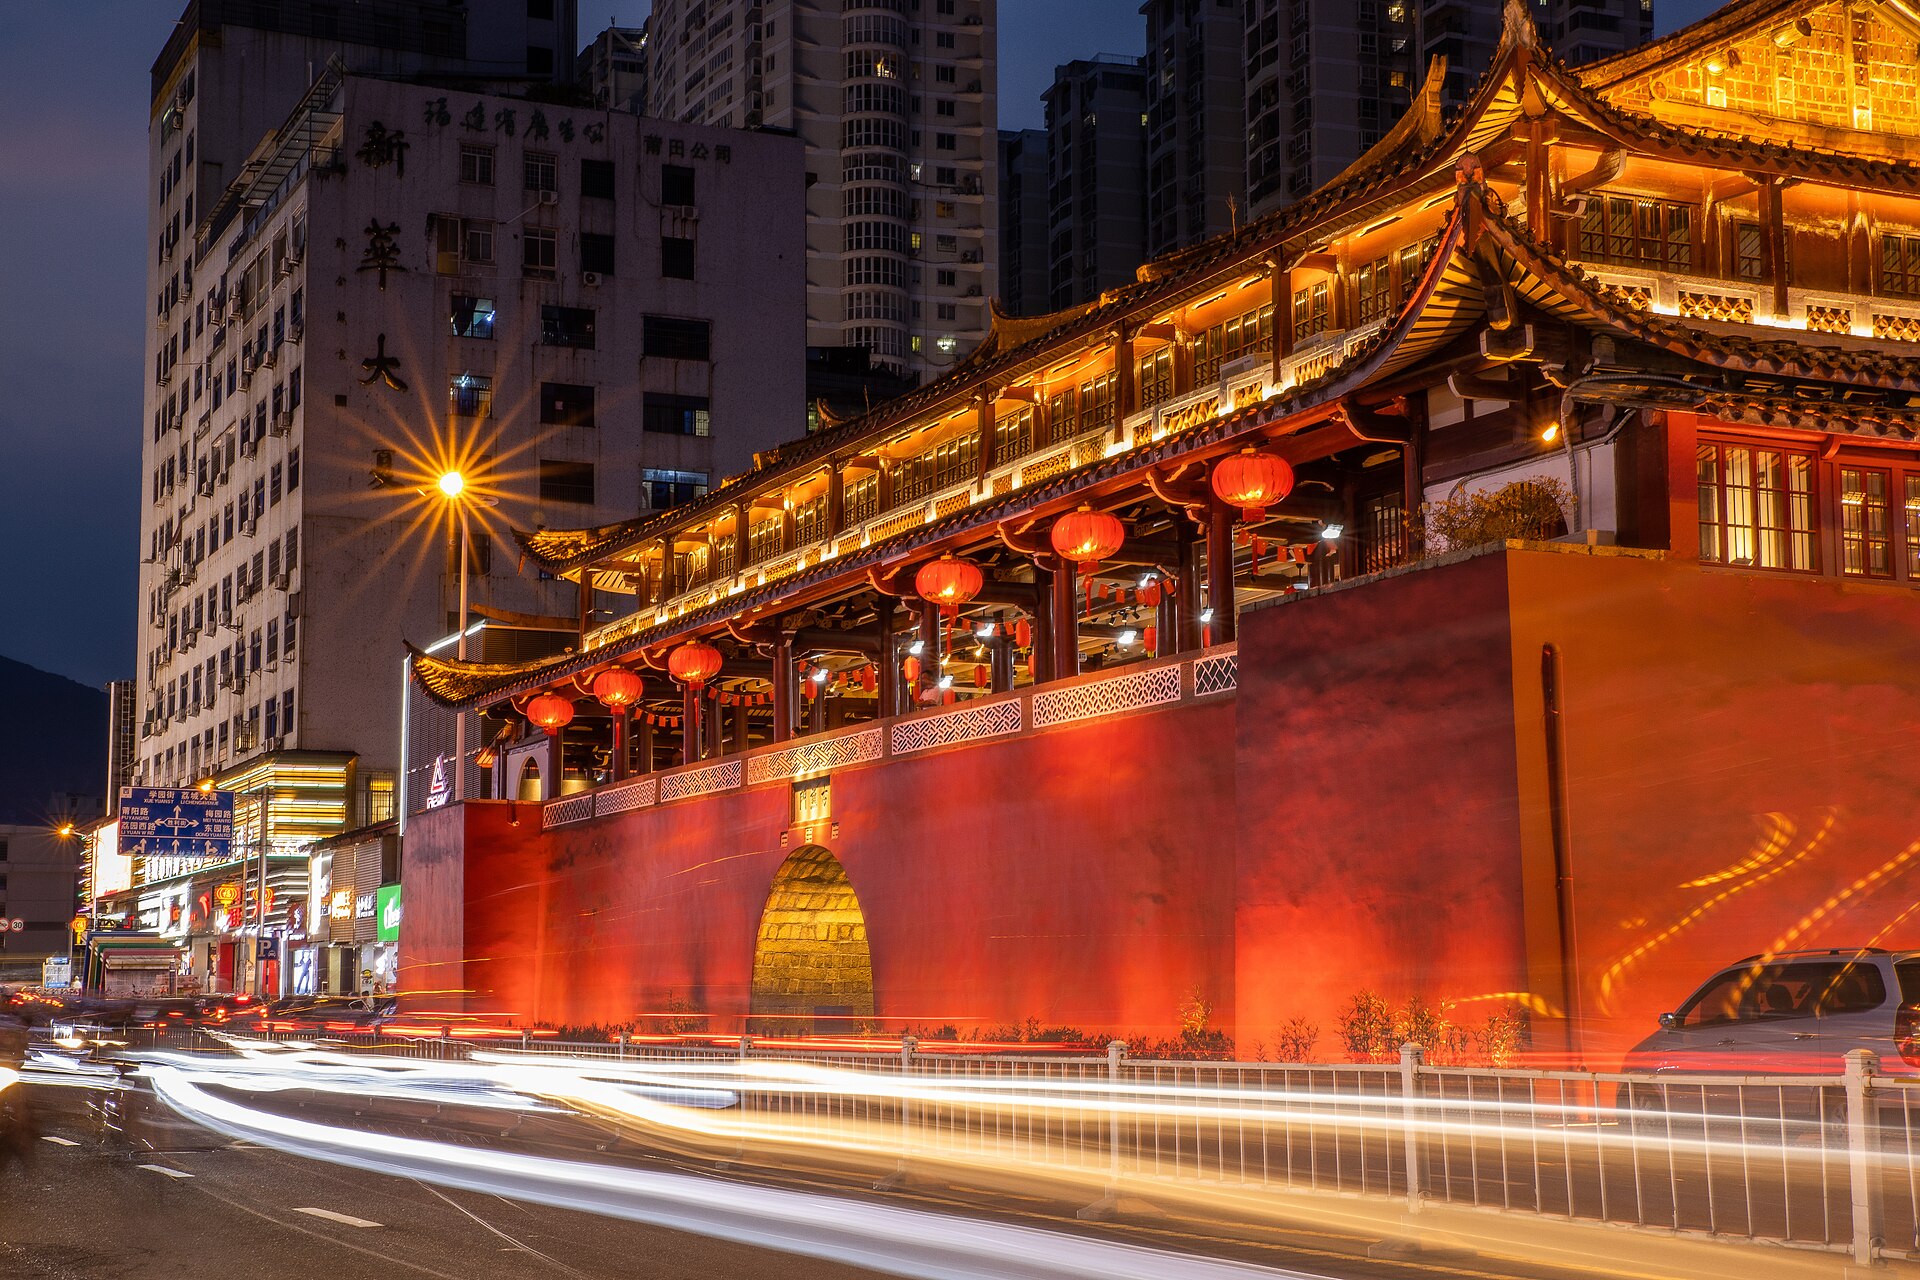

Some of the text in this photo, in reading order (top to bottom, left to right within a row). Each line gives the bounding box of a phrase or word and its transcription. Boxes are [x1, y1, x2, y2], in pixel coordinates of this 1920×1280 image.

[149, 791, 218, 801] 学园街 荔城大道
[122, 807, 149, 816] 莆阳路
[205, 810, 232, 819] 梅园路
[121, 822, 156, 831] 荔园西路
[204, 824, 231, 833] 东园路
[257, 940, 272, 958] P
